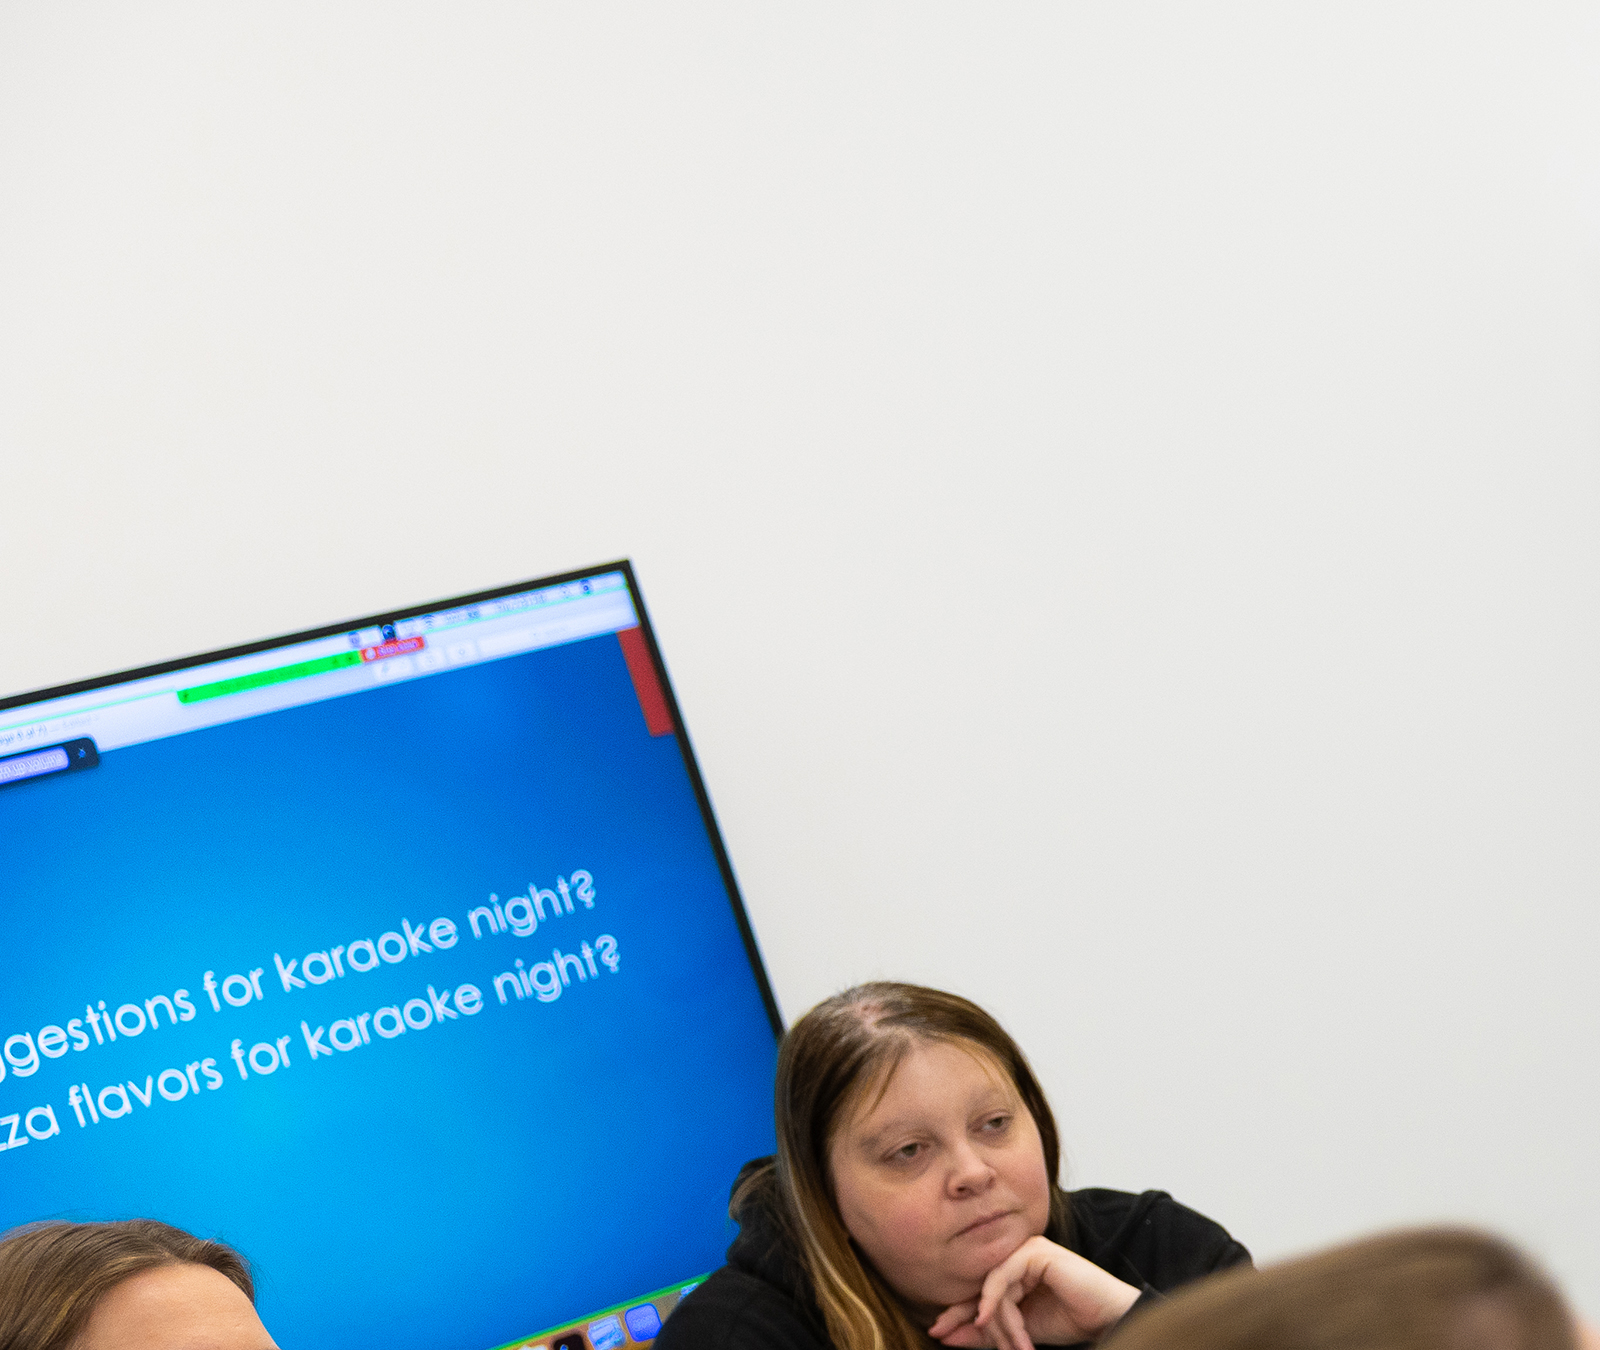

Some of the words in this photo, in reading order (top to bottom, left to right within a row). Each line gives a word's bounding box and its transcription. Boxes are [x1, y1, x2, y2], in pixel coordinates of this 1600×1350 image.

[0, 988, 197, 1083] gestions
[203, 970, 264, 1012] for
[274, 917, 459, 992] karaoke
[468, 869, 596, 939] night?
[0, 1104, 60, 1150] za
[69, 1057, 223, 1127] flavors
[230, 1038, 291, 1080] for
[301, 983, 483, 1060] karaoke
[493, 934, 620, 1004] night?
